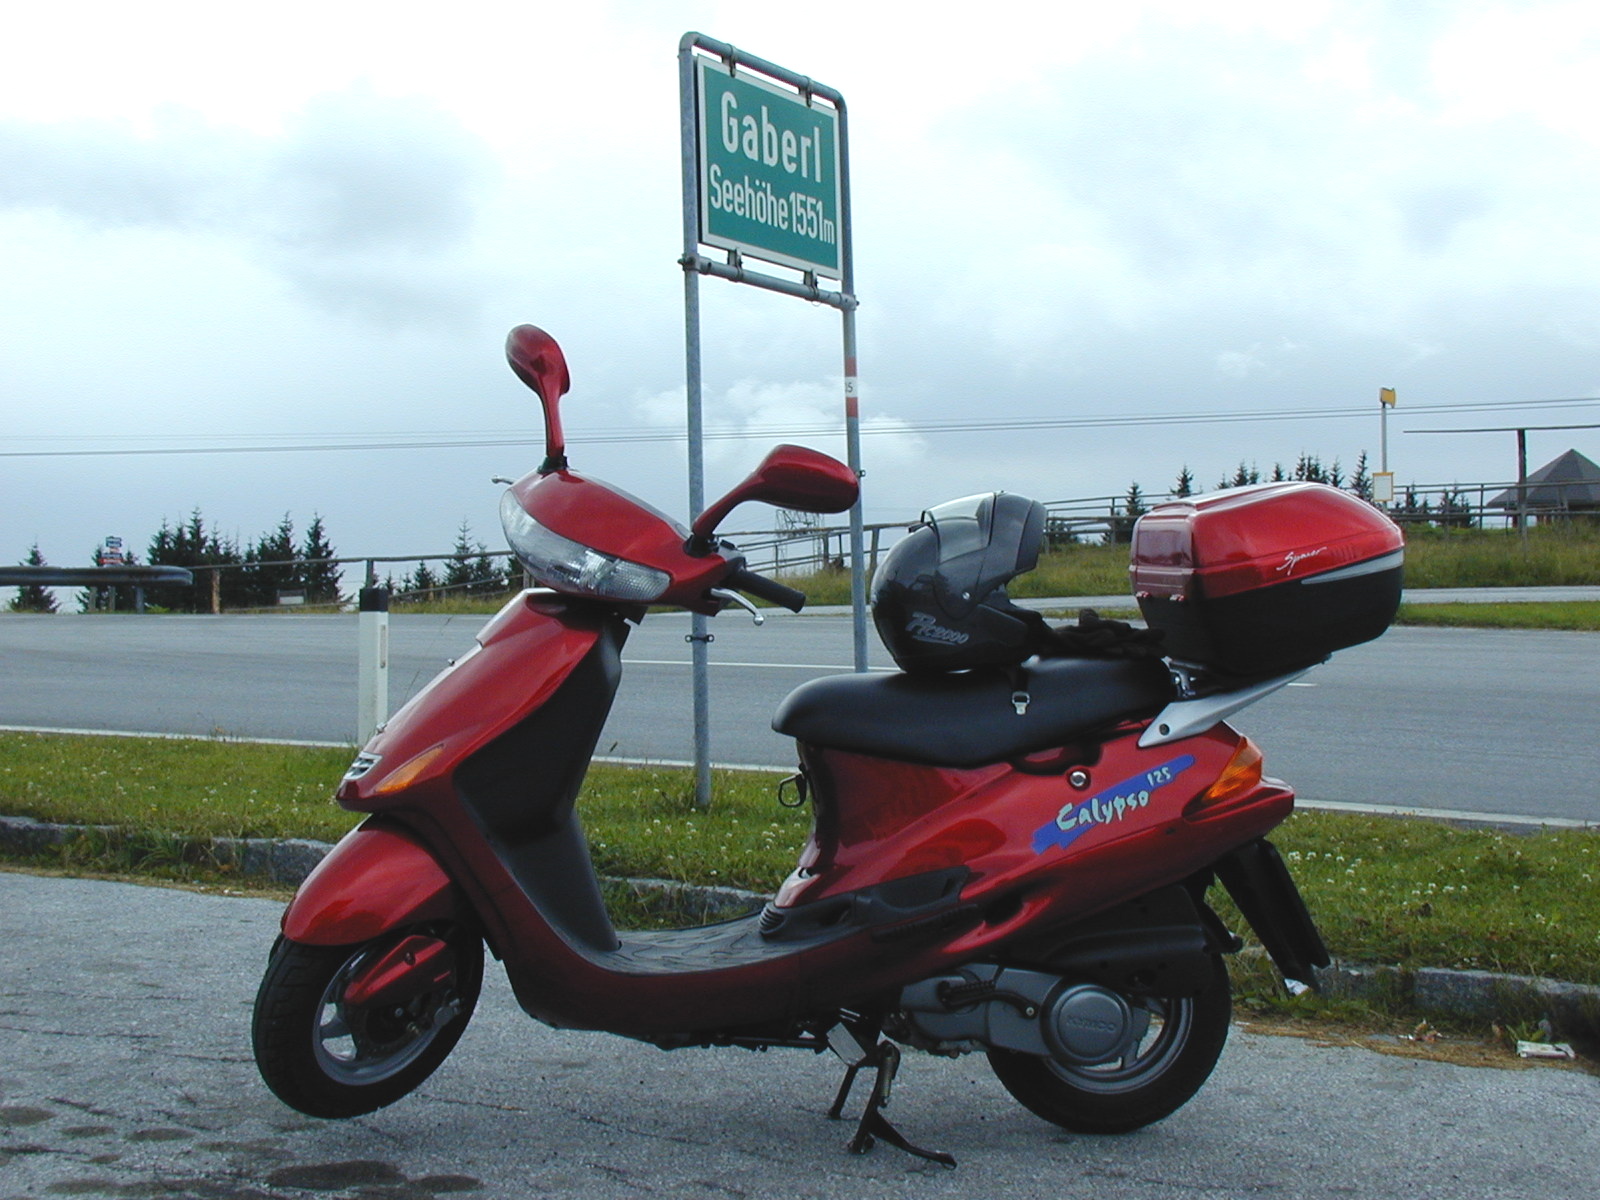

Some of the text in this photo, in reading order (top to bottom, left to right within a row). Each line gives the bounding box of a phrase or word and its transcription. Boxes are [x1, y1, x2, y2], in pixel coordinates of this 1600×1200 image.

[721, 91, 821, 183] Gaberl
[710, 164, 788, 231] Seehöhe
[1056, 766, 1171, 831] Calypso 125
